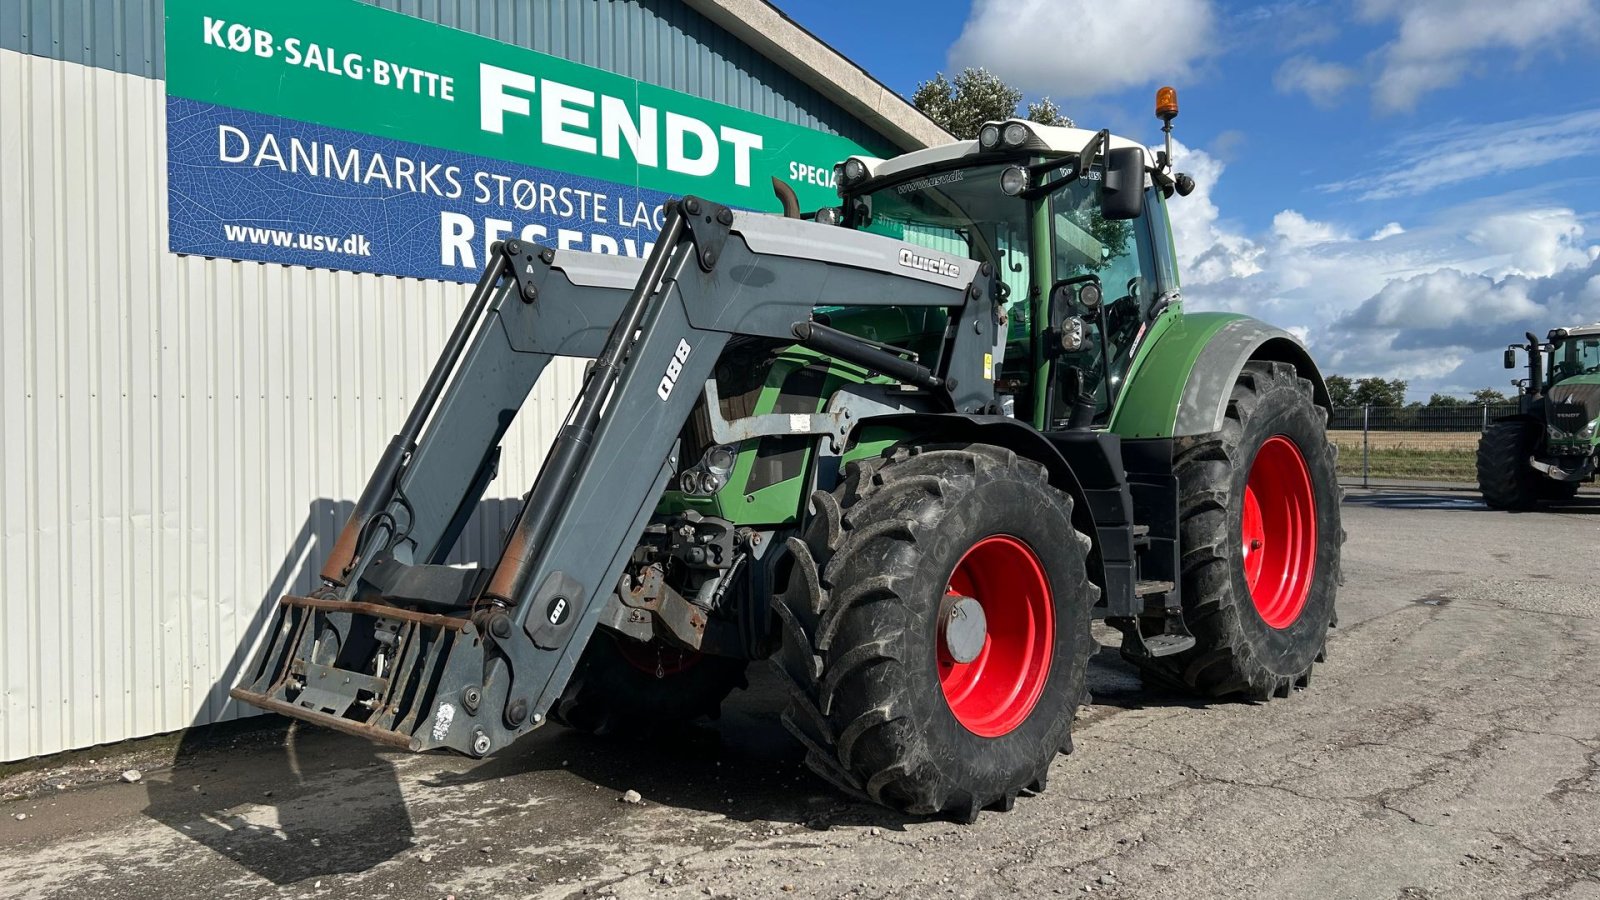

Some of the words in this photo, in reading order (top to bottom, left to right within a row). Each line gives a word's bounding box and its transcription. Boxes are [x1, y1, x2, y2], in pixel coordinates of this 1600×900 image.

[479, 63, 763, 187] FENDT
[219, 124, 462, 199] DANMARKS
[474, 171, 607, 224] STØRSTE
[223, 224, 371, 257] www.usv.dk
[899, 248, 960, 278] Quicke
